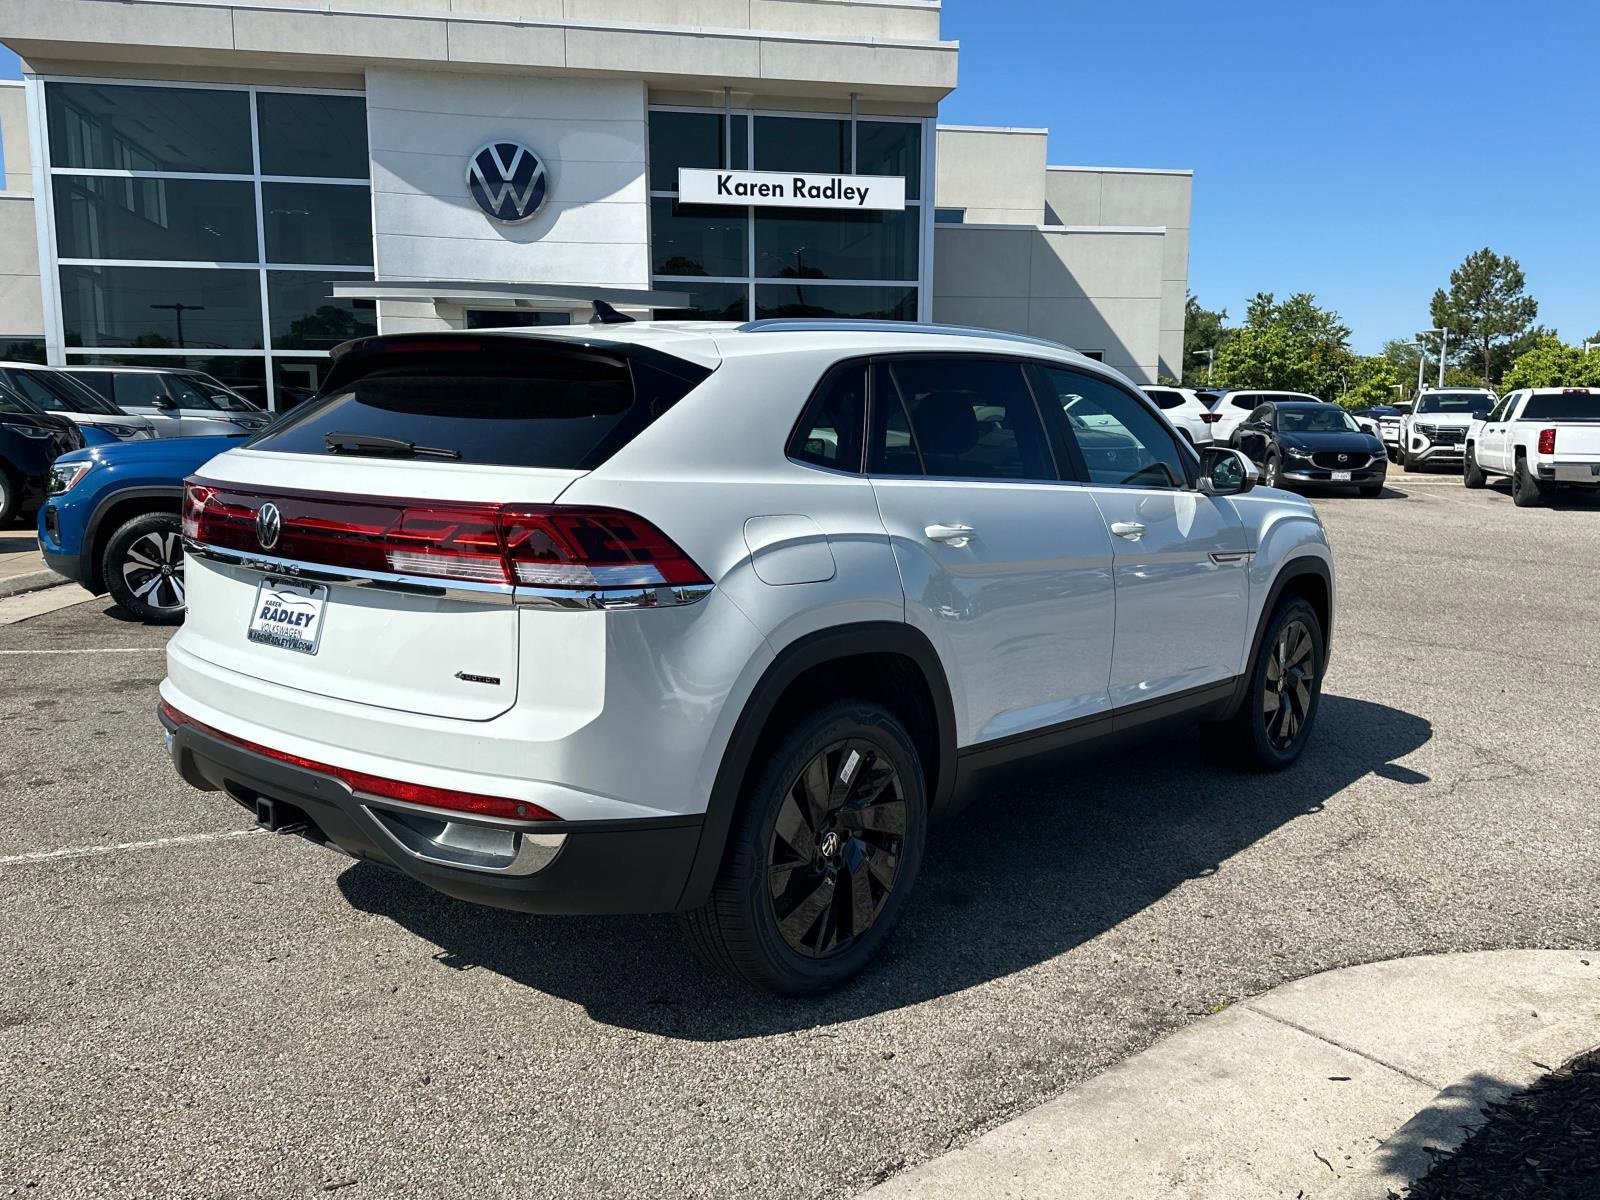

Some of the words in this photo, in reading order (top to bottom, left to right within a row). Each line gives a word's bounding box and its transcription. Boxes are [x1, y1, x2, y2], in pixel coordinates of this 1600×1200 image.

[717, 174, 784, 198] Karen
[792, 177, 870, 206] Radley
[265, 599, 282, 608] KAREN
[260, 606, 316, 628] RADLEY
[261, 622, 303, 639] VOLKSWAGEN
